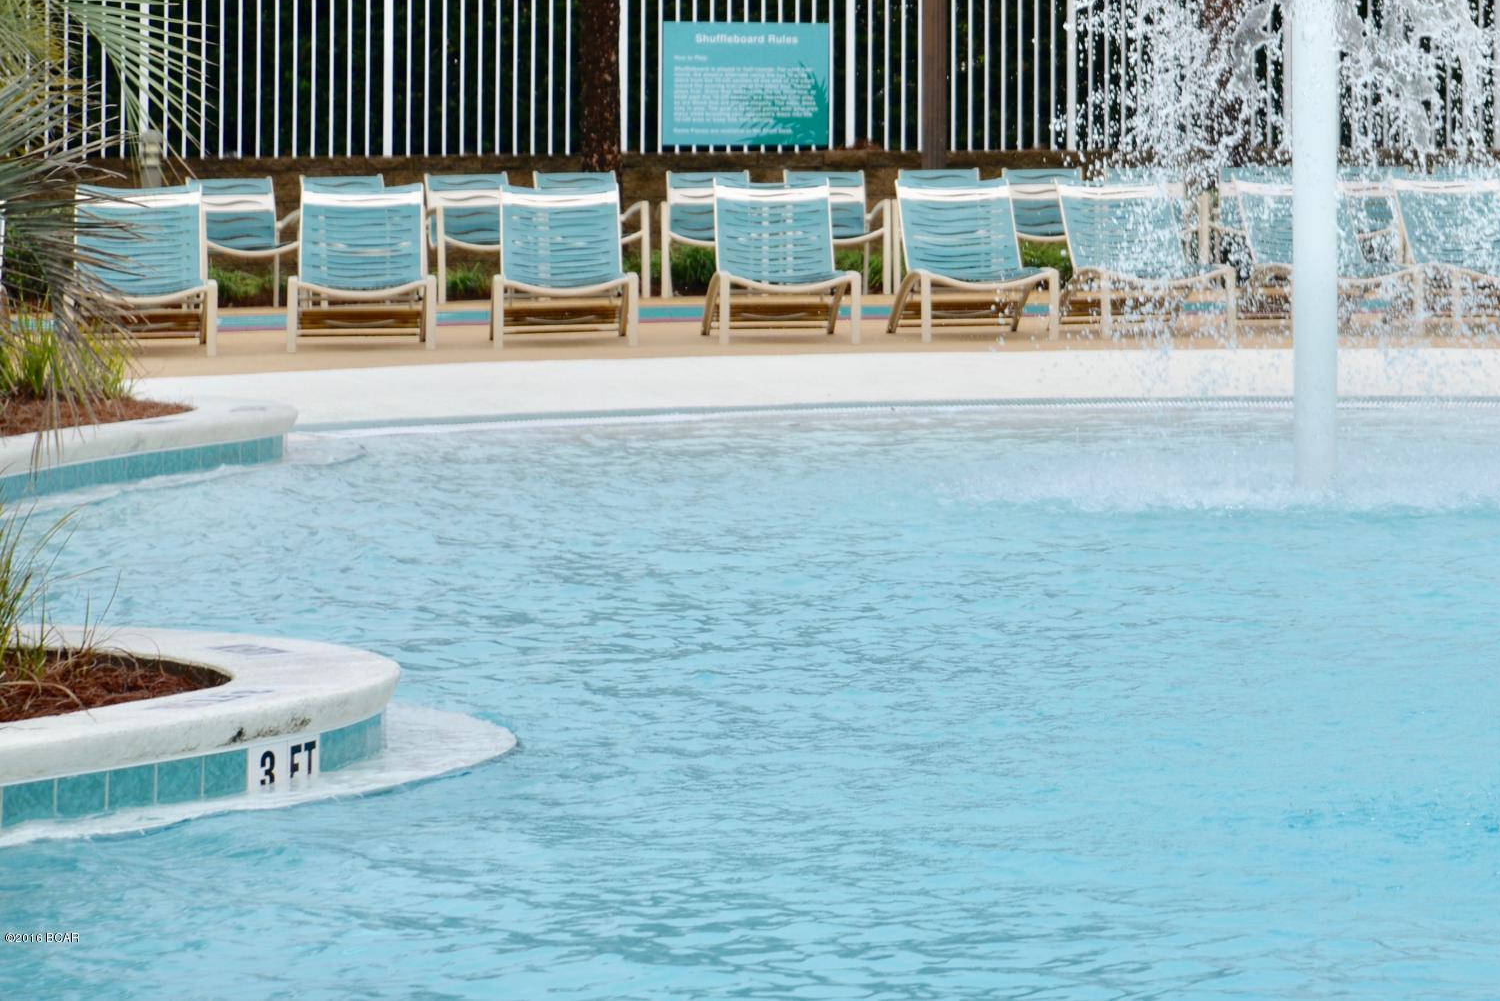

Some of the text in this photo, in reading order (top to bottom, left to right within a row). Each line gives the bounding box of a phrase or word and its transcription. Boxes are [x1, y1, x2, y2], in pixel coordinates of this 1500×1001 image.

[695, 33, 798, 45] Shuffleboard Rules
[260, 740, 316, 785] 3 FT
